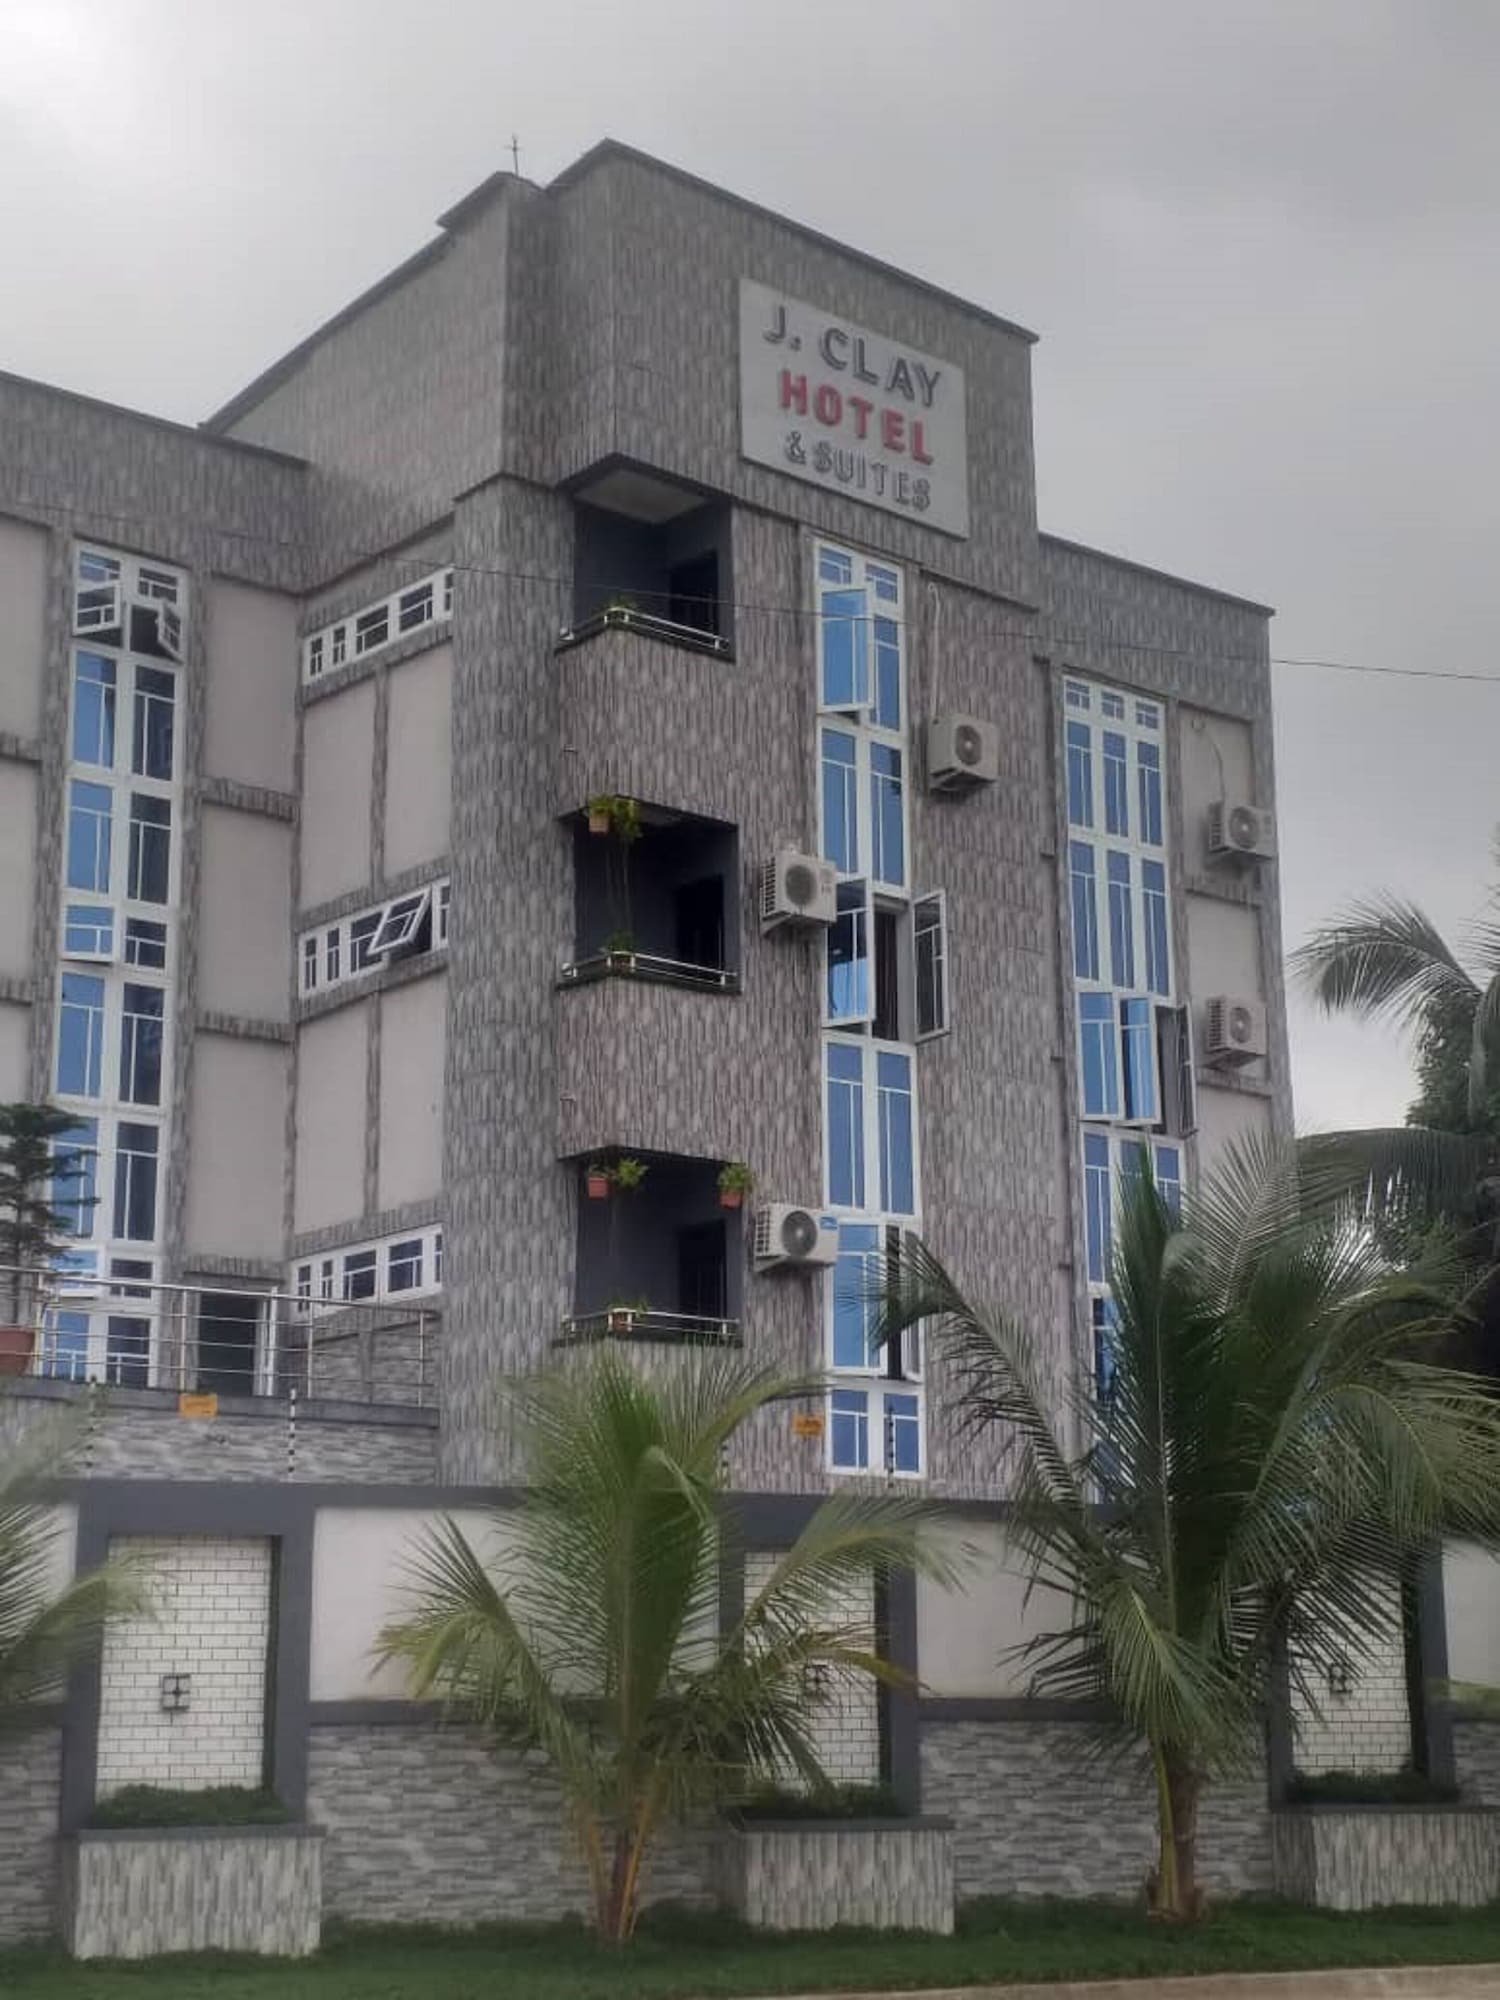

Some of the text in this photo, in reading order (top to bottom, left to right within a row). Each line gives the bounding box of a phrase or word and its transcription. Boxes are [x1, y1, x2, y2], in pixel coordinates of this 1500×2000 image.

[763, 306, 941, 408] J. CLAY
[778, 369, 935, 467] HOTEL
[786, 431, 932, 512] & SUITES
